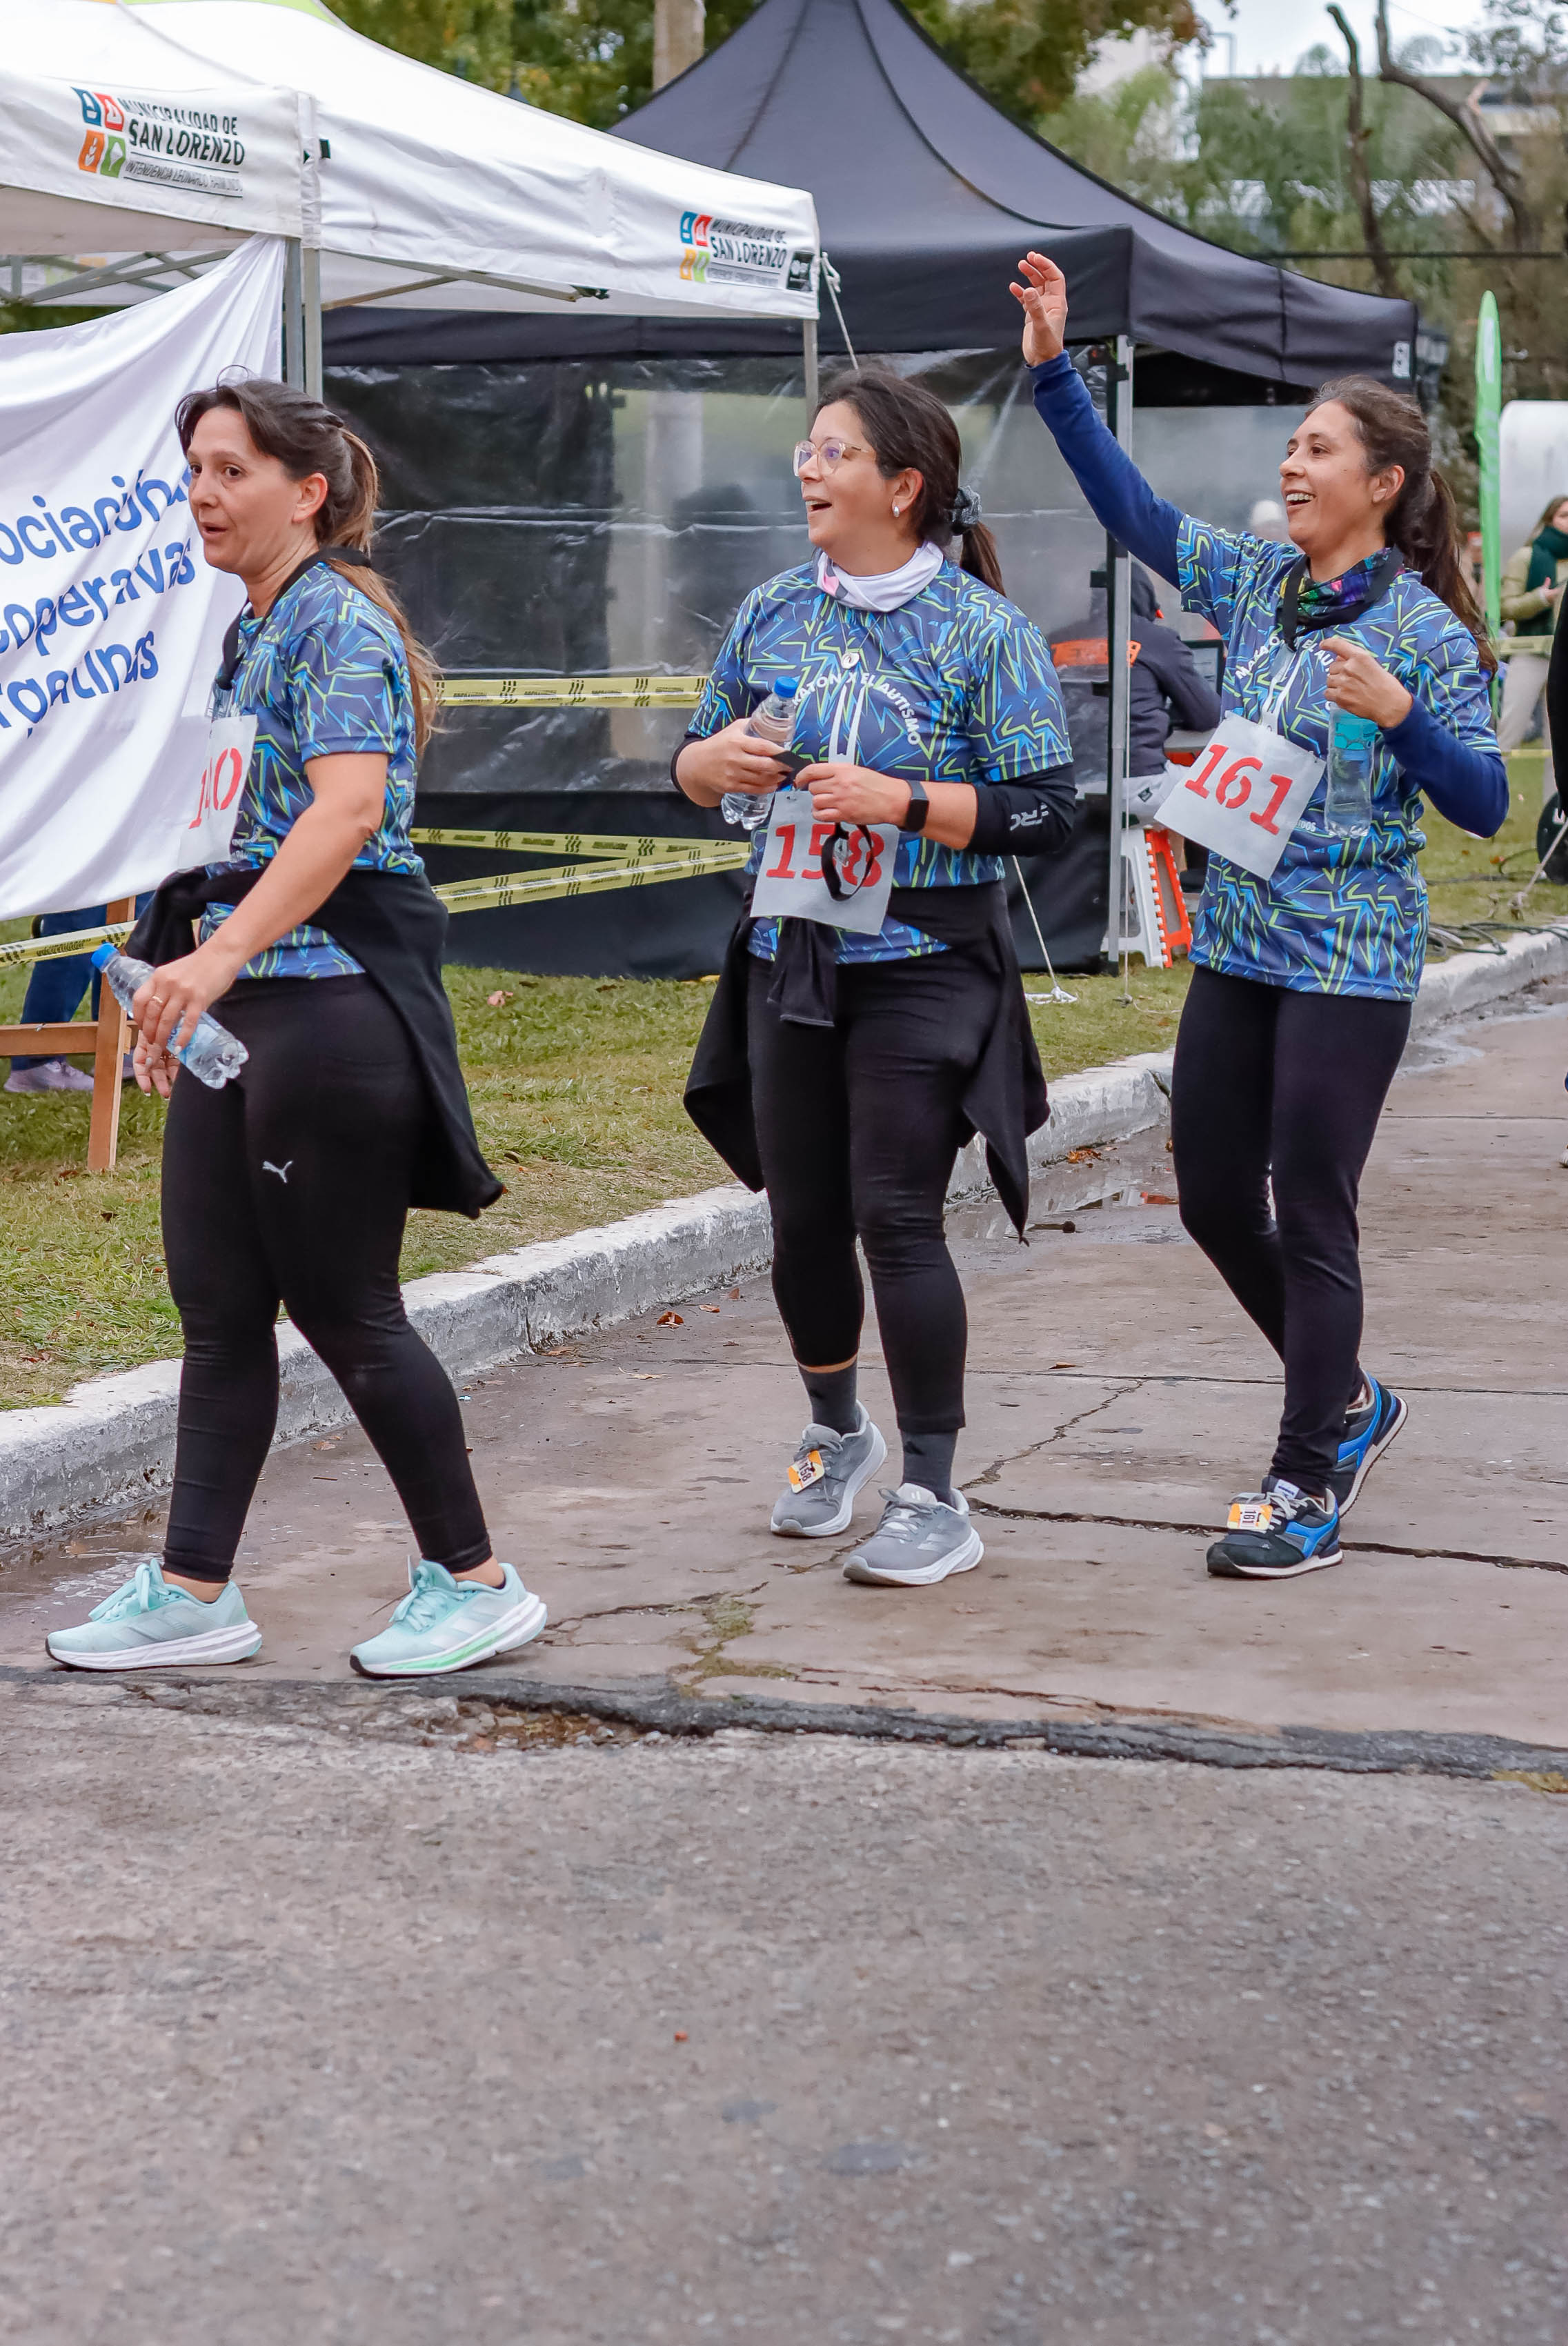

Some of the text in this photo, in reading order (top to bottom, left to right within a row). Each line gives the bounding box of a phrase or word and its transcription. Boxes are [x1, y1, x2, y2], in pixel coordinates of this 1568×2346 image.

[128, 118, 245, 166] SAN LORENZO
[222, 115, 238, 135] DE
[711, 236, 734, 260] SAN
[846, 672, 858, 684] X
[860, 672, 877, 686] EL
[880, 683, 922, 746] AUTISMO
[1184, 744, 1293, 836] 161
[766, 822, 886, 888] 158
[800, 1462, 812, 1482] 158
[1242, 1511, 1256, 1523] 161
